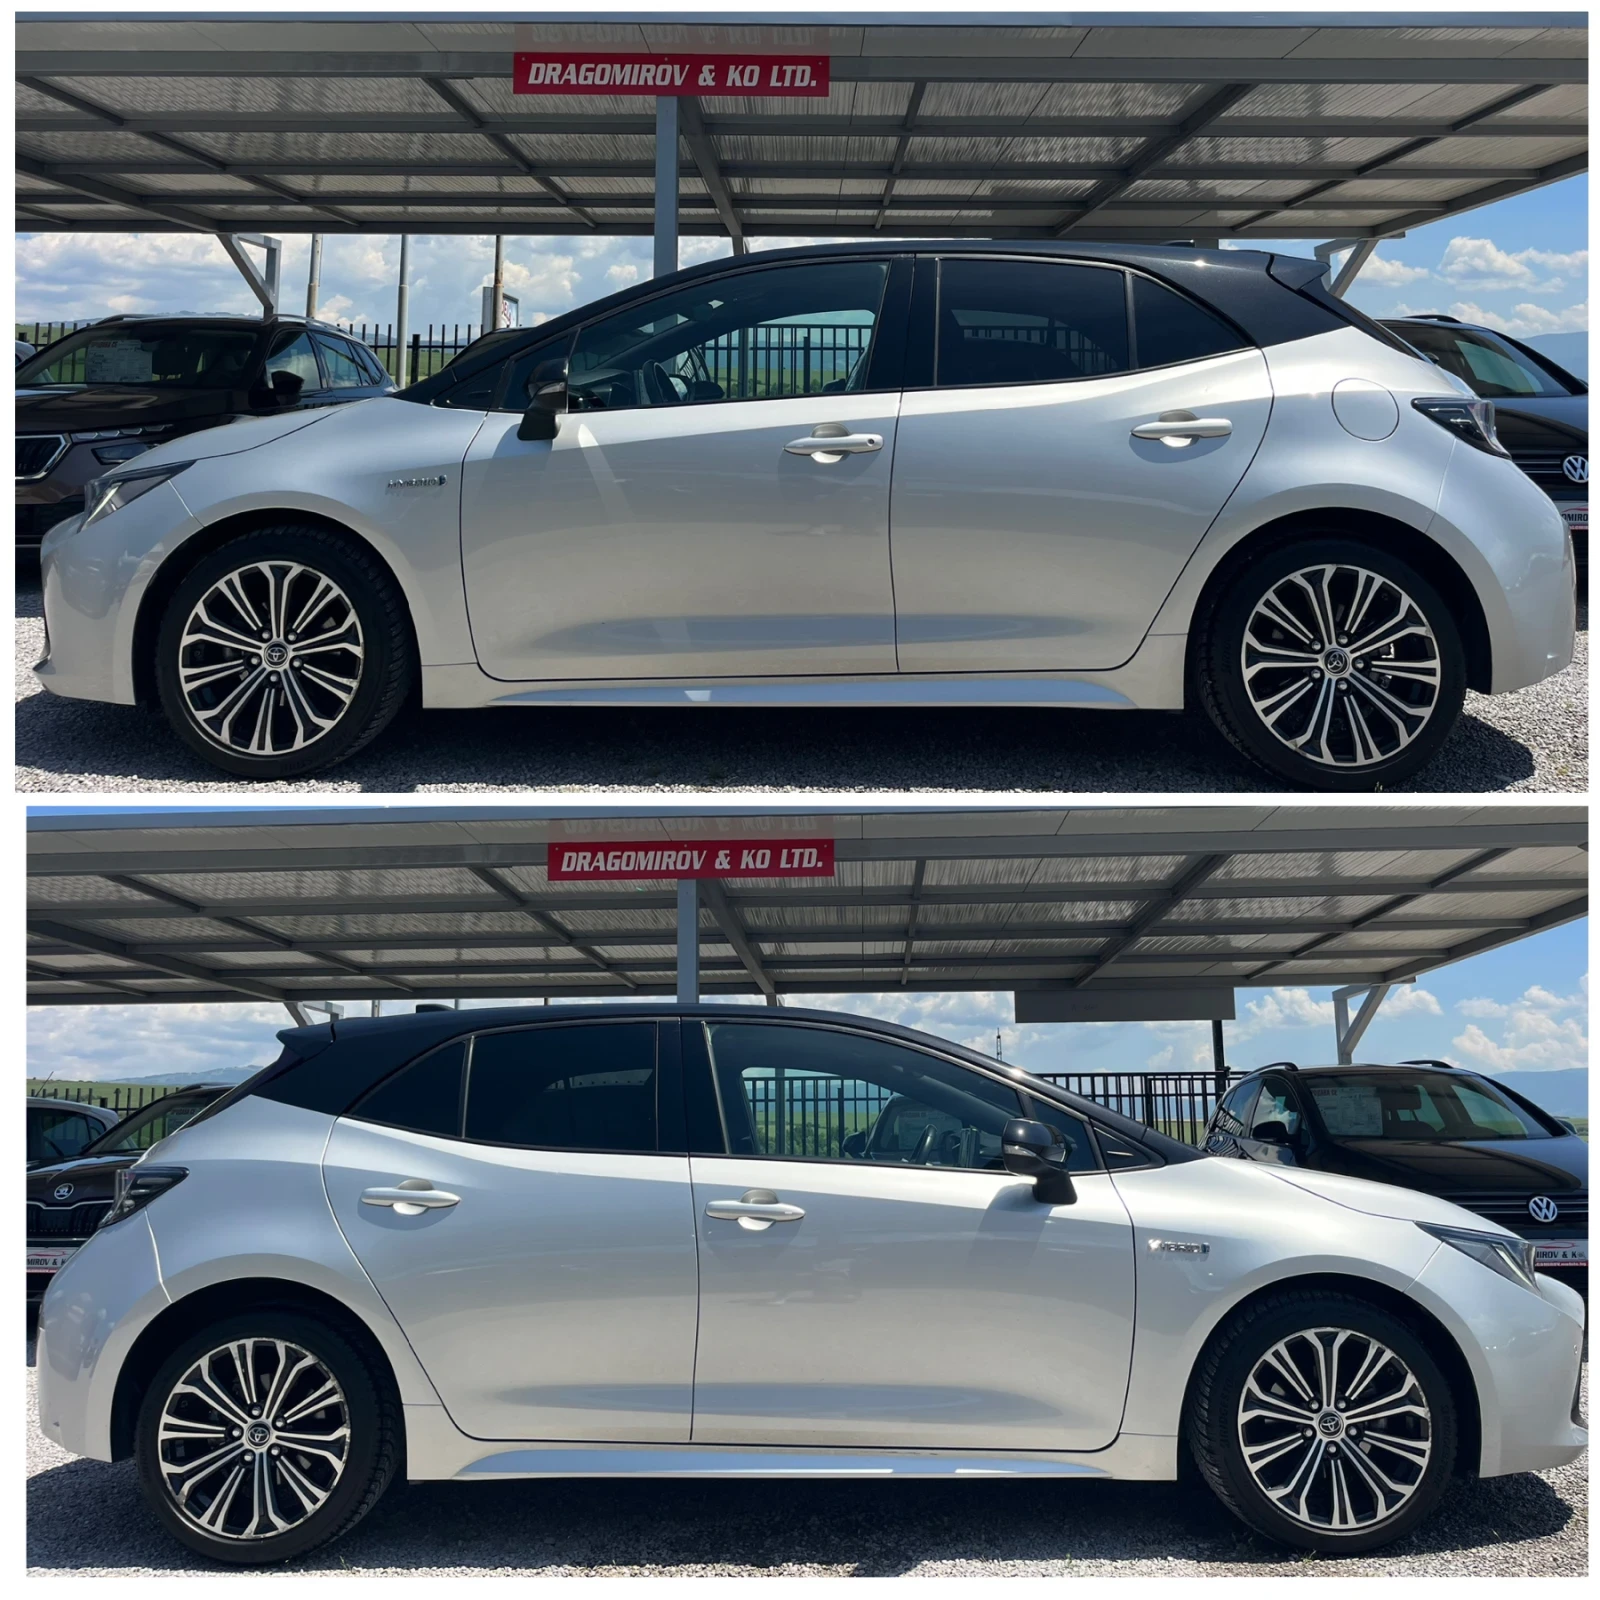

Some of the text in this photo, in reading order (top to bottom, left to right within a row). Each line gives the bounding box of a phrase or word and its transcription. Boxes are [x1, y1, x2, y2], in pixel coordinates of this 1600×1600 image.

[528, 63, 817, 87] DRAGOMIROV & KO LTD.
[561, 847, 823, 872] DRAGOMIROV & KO LTD.
